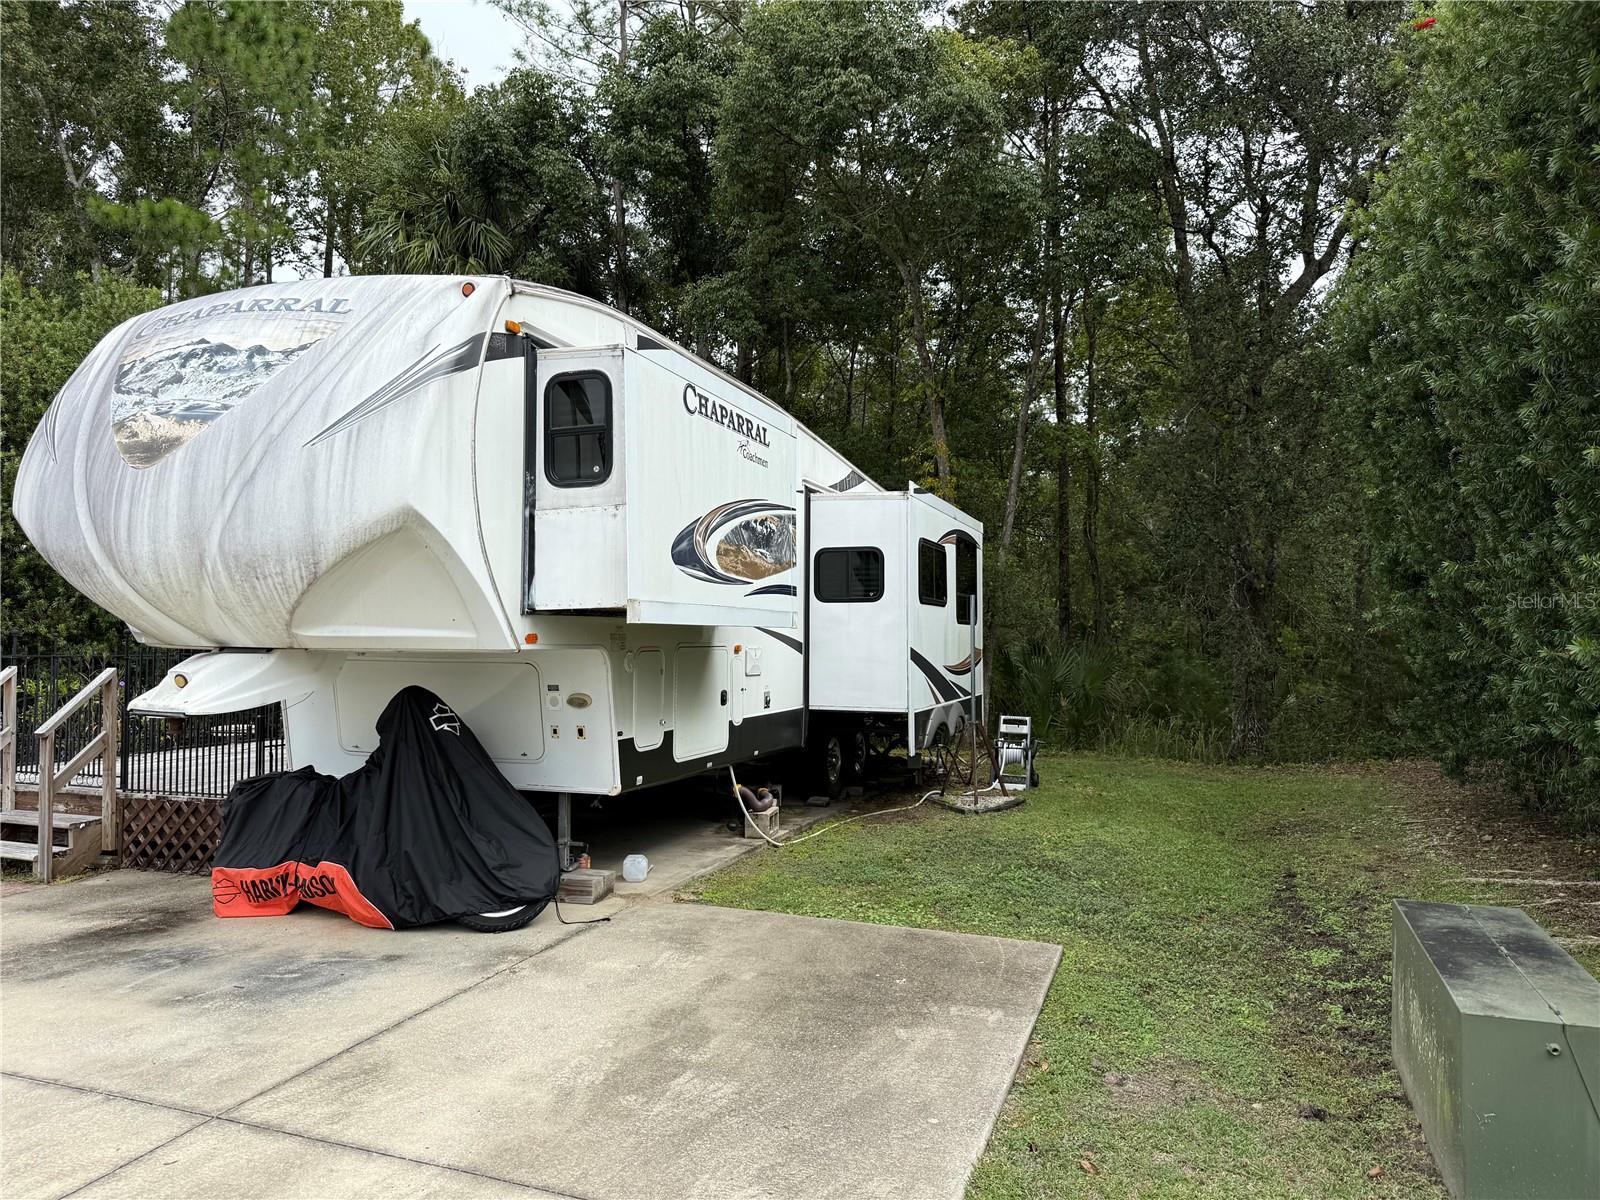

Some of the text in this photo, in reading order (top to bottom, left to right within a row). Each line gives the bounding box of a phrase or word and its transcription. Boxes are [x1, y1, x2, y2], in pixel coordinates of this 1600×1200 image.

[135, 297, 353, 340] CHAPARRAL
[682, 382, 771, 448] CHAPARRAL
[742, 448, 769, 469] Coachmen
